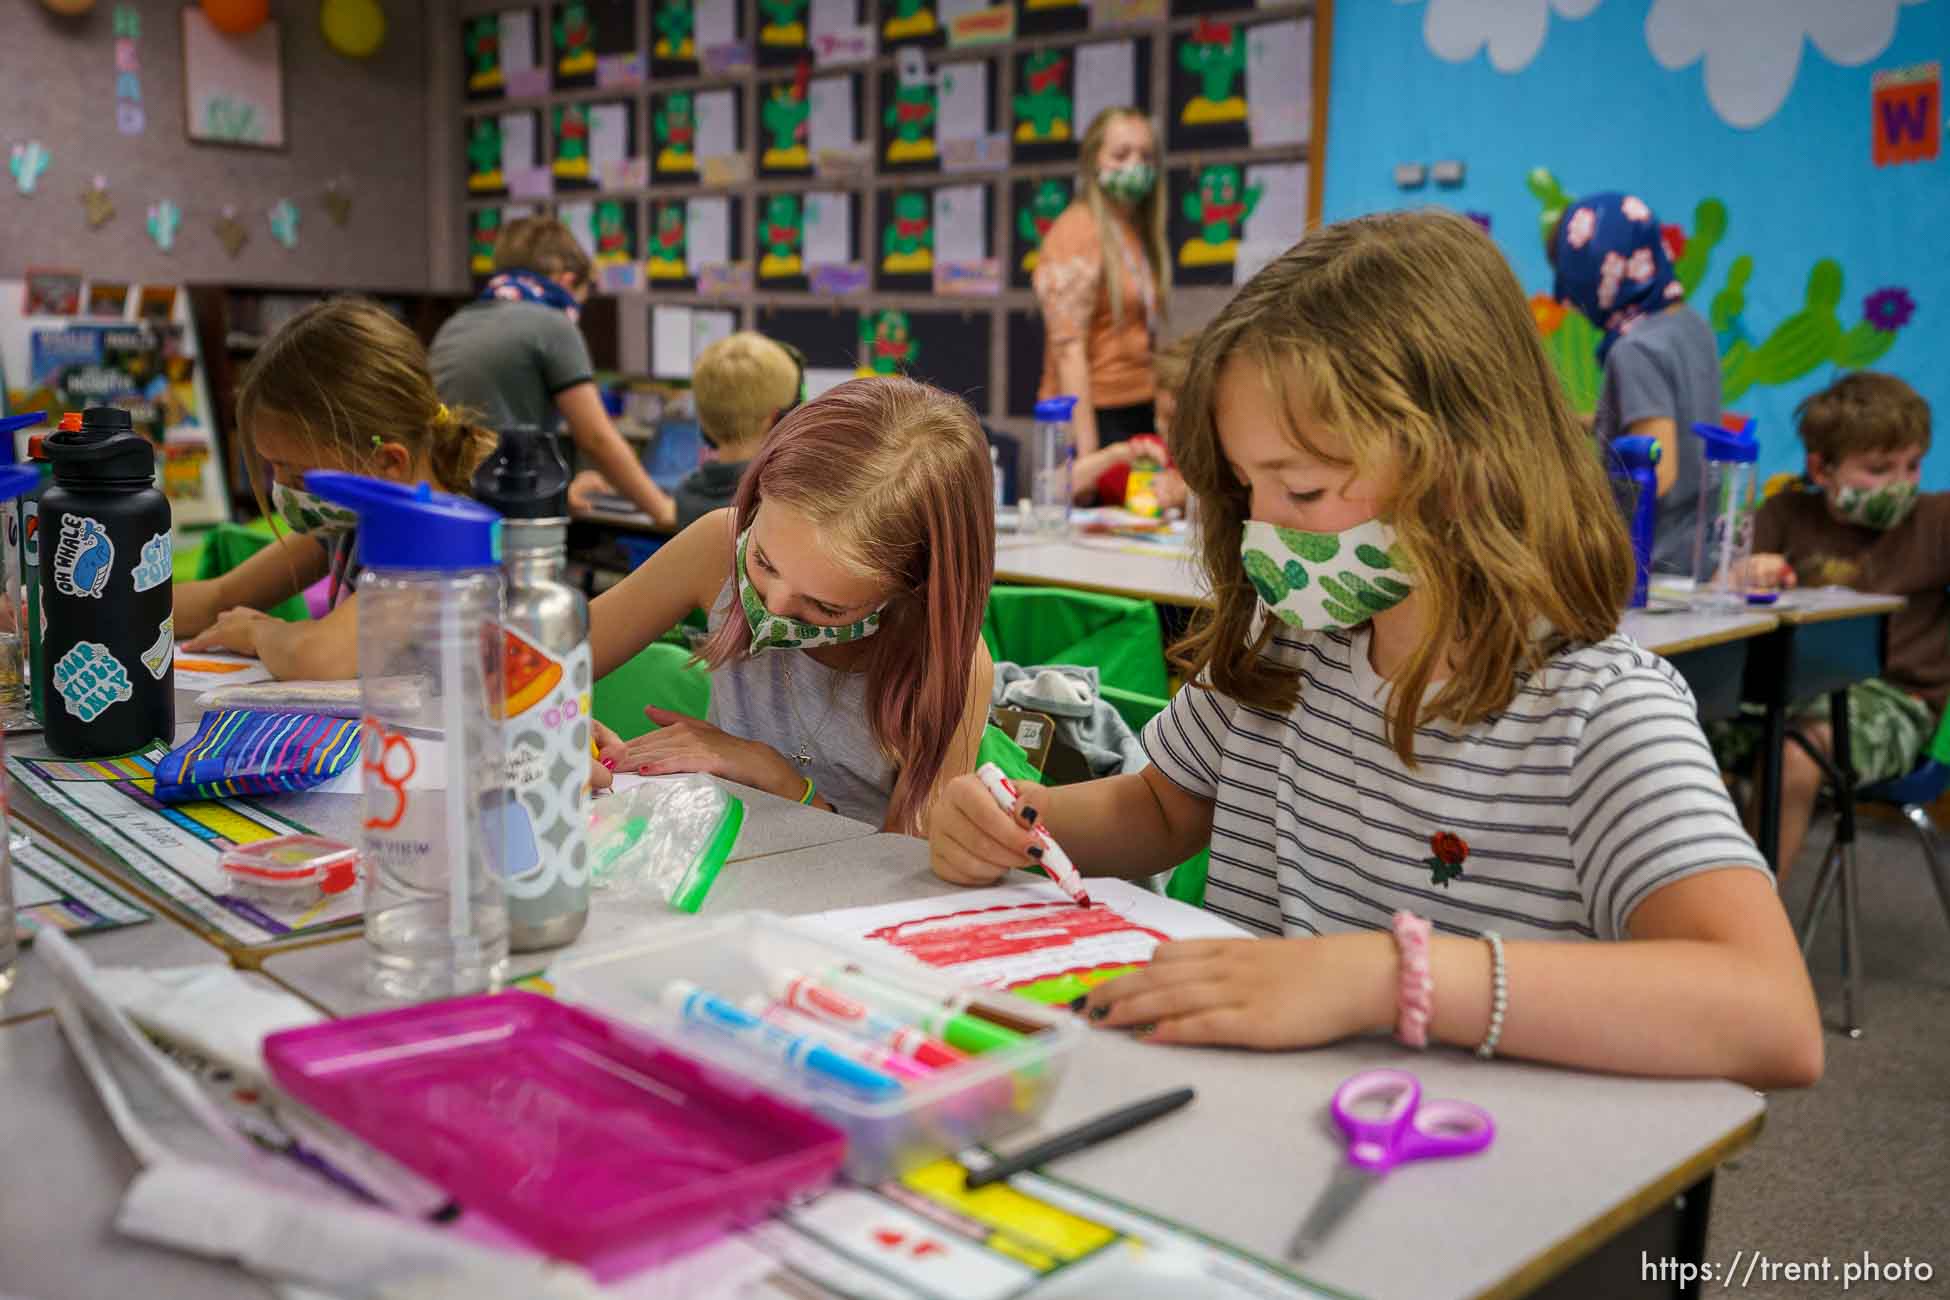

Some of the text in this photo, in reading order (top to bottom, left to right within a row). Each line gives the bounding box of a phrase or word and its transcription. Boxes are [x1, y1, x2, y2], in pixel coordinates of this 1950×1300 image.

[1882, 94, 1928, 144] W
[57, 516, 82, 592] OH WHALE
[56, 643, 96, 682] GOOD
[63, 655, 118, 700] VIBES
[79, 669, 130, 720] ONLY
